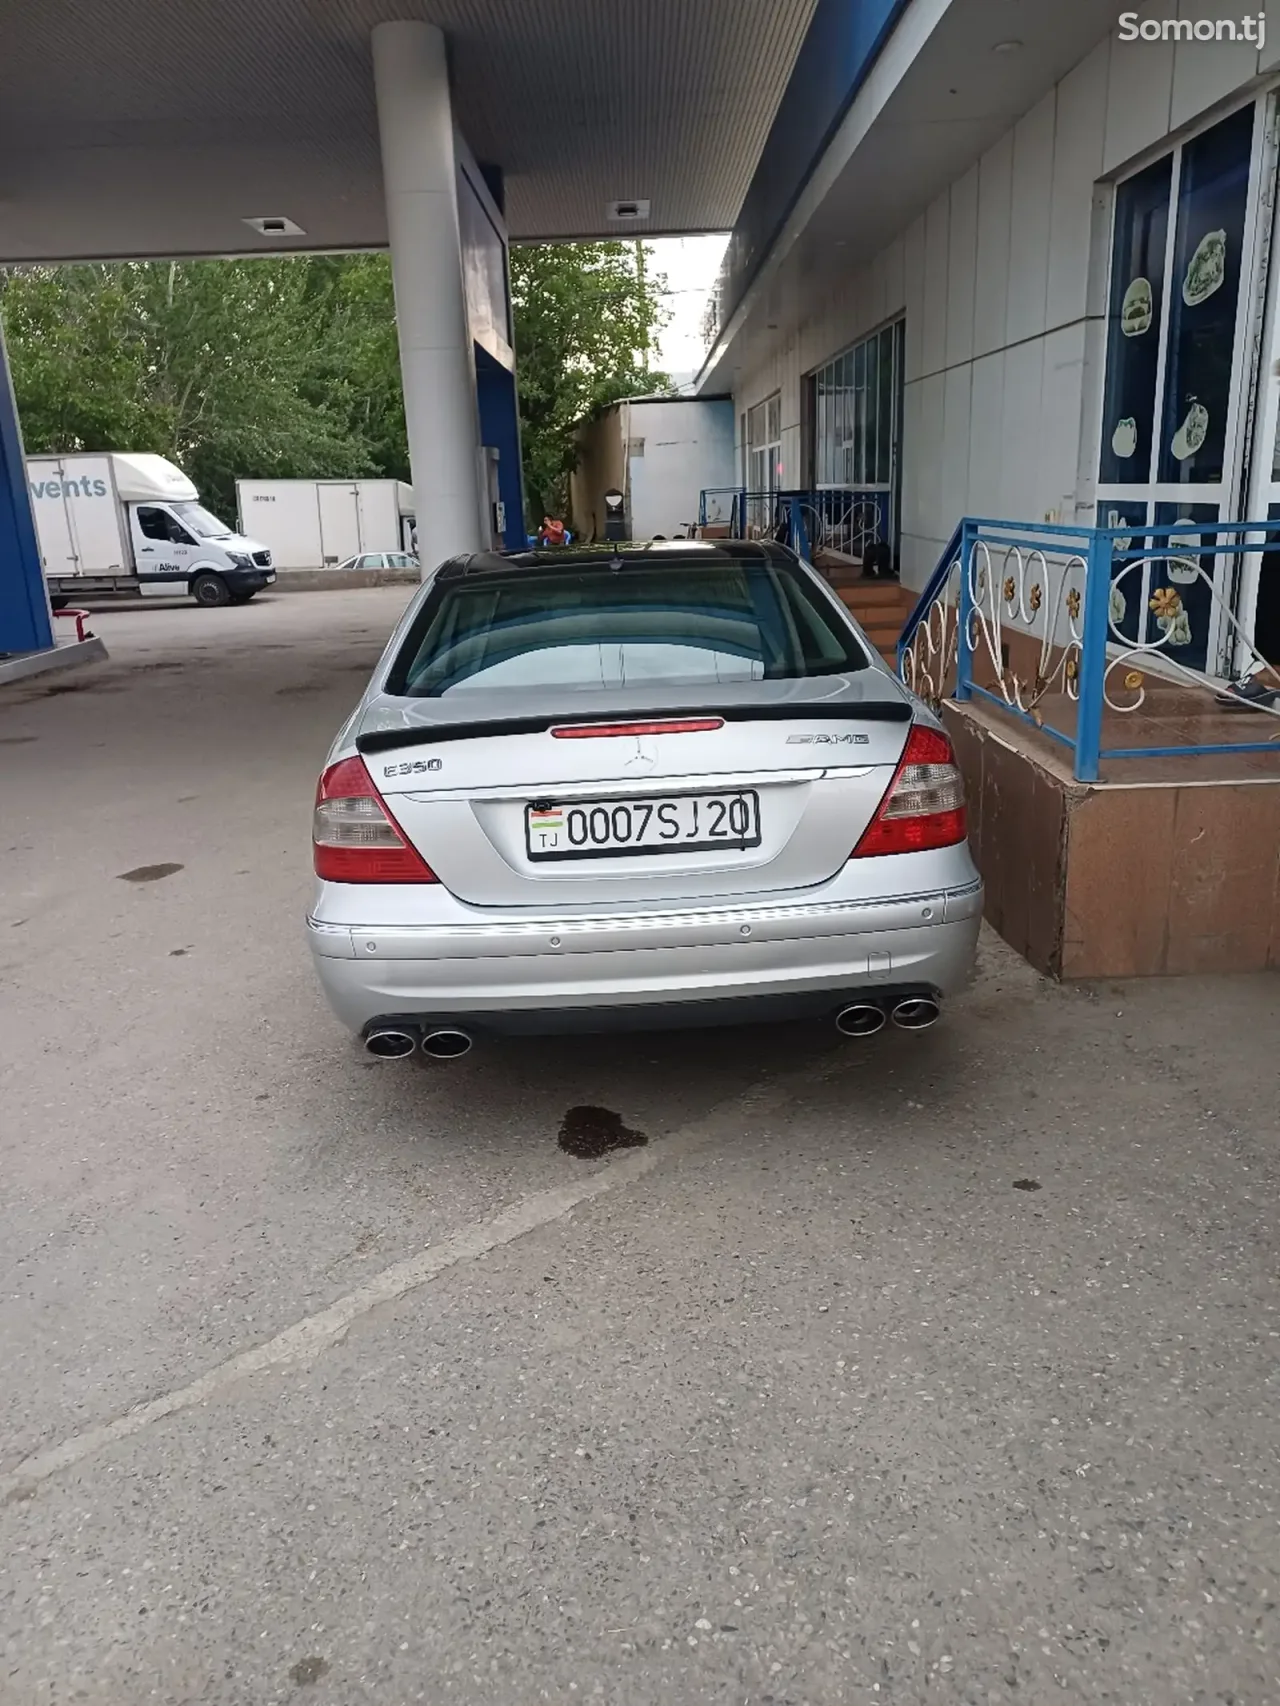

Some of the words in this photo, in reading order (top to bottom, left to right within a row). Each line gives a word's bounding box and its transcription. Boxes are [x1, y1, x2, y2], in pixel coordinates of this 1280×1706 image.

[814, 733, 870, 745] AMG
[383, 758, 443, 778] E350
[566, 797, 750, 846] 0007SJ20
[539, 832, 559, 848] TJ
